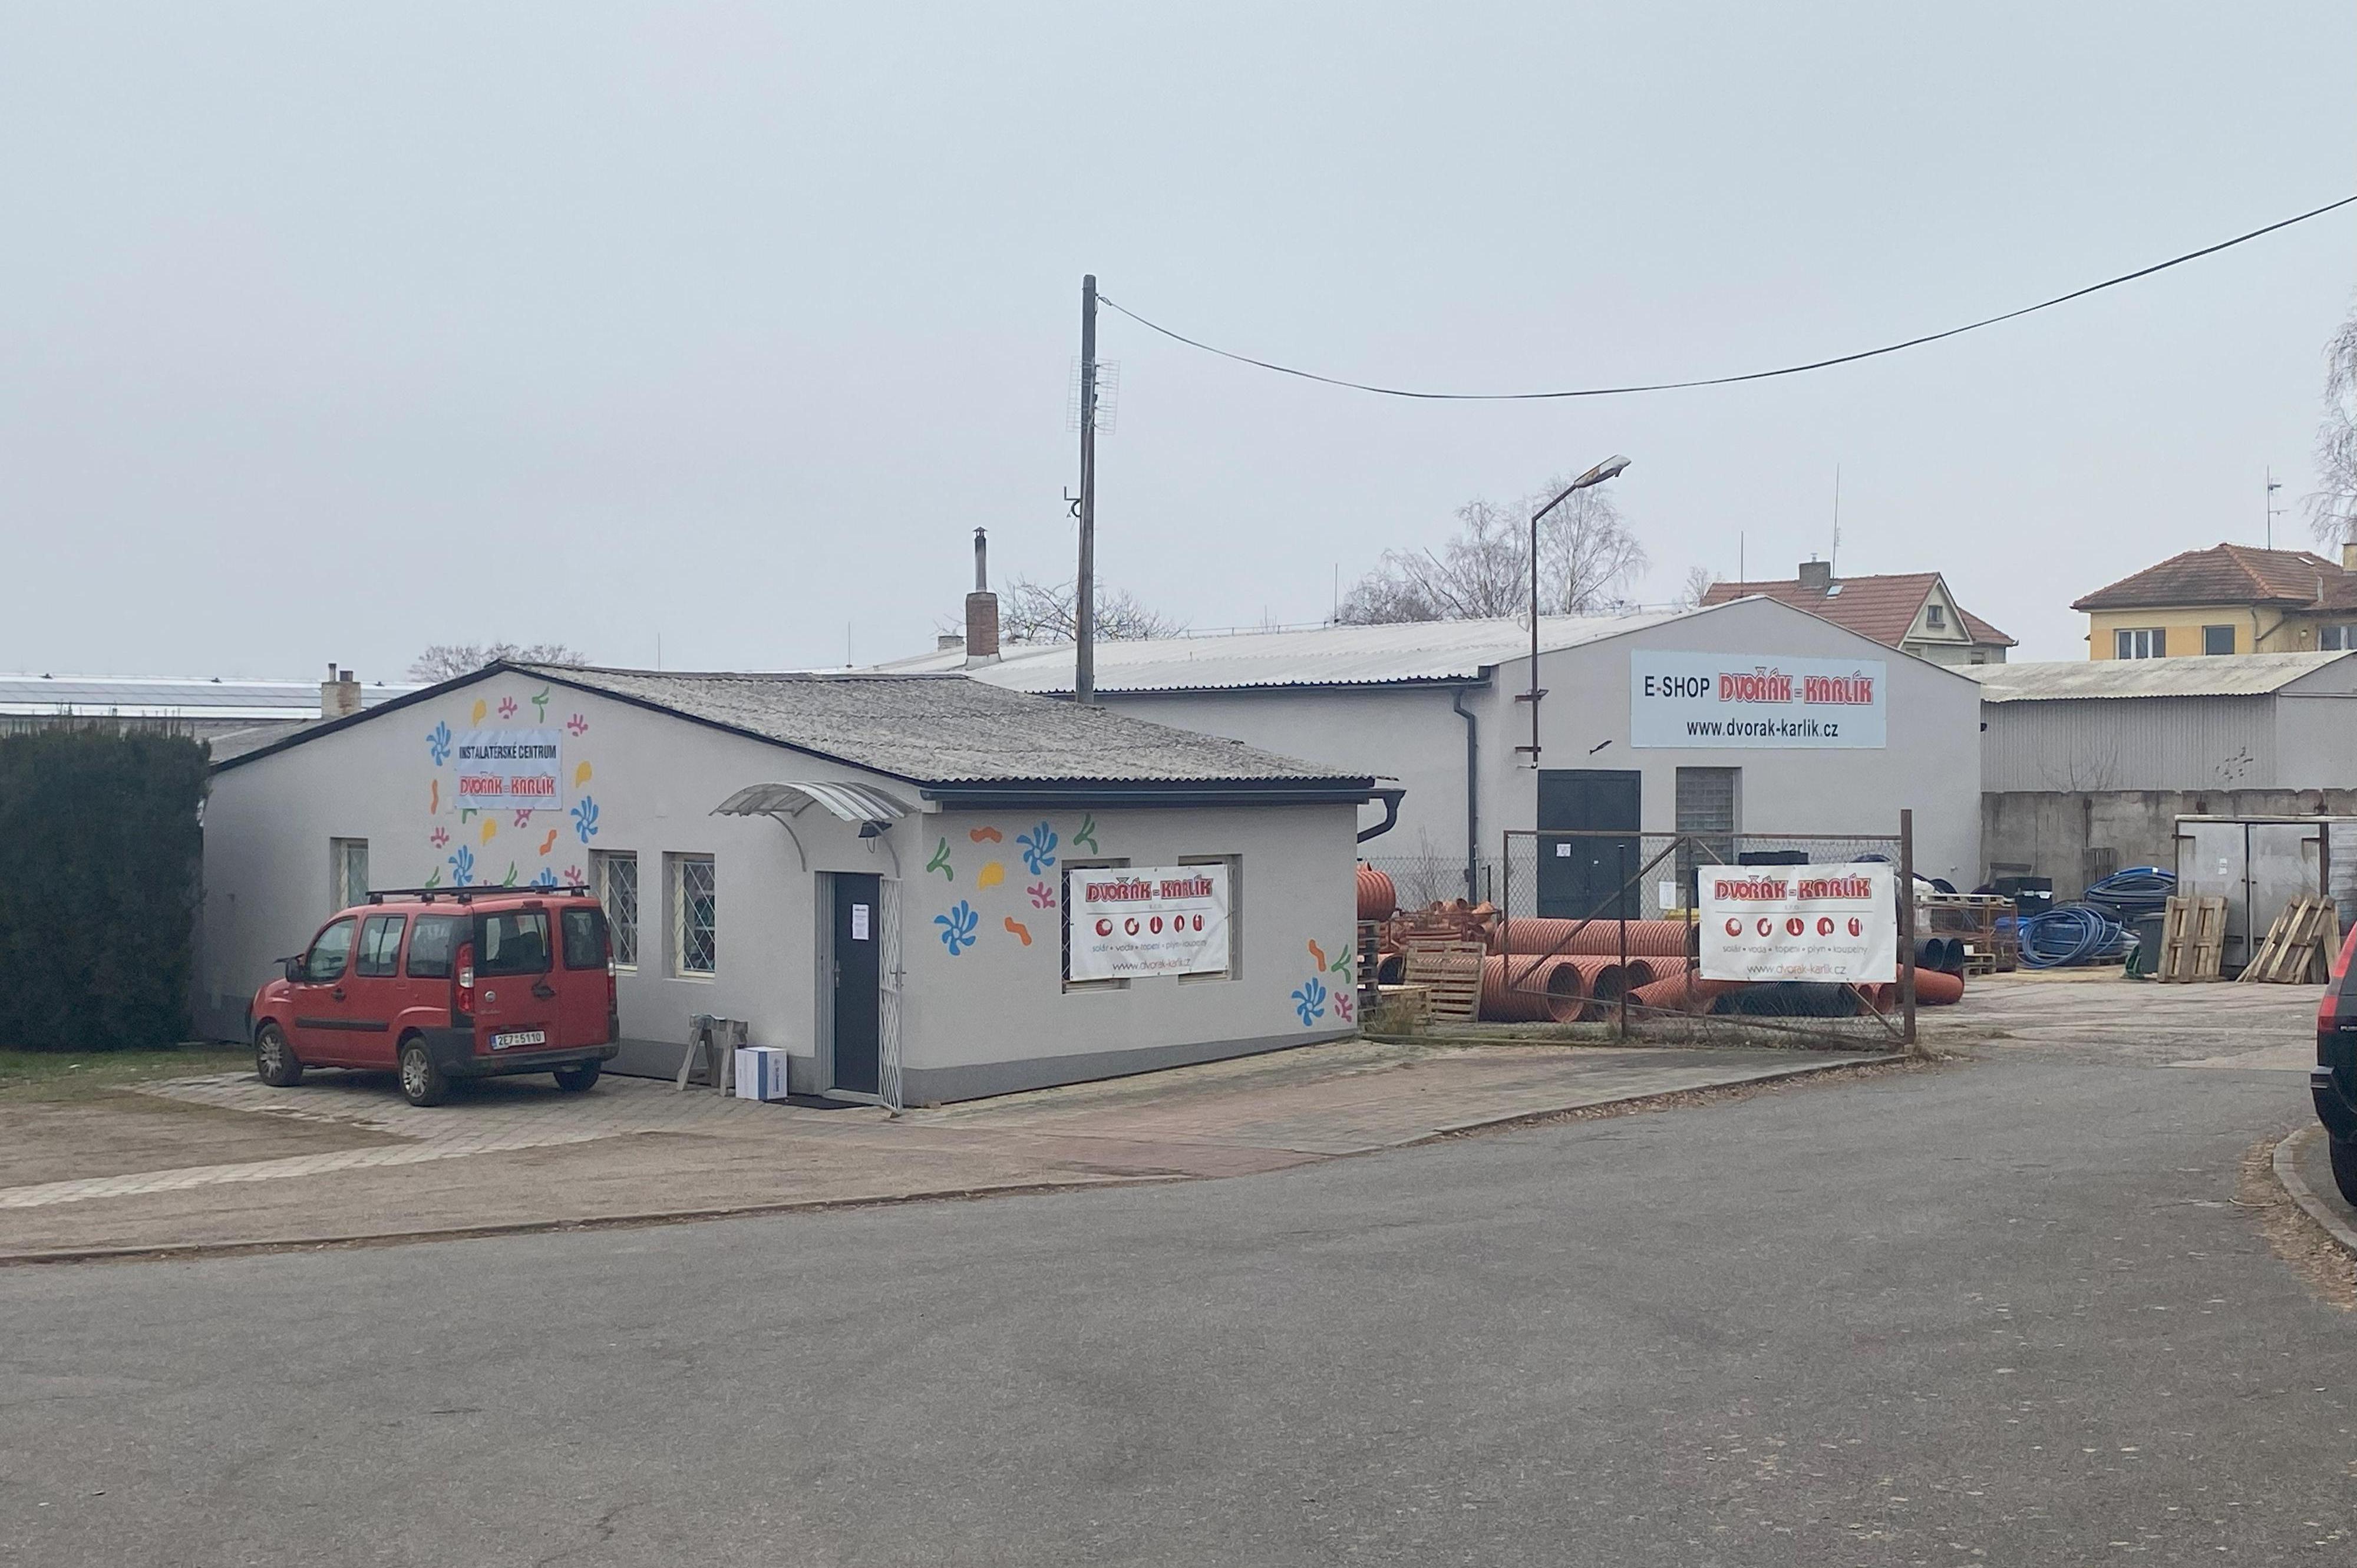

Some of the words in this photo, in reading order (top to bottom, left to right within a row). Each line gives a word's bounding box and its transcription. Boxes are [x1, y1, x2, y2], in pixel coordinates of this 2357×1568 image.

[1644, 676, 1710, 698] E-SHOP
[1686, 718, 1839, 738] www.dvorak-karlik.cz
[518, 745, 557, 759] CENTRUM
[1748, 945, 1767, 953] voda
[1807, 945, 1825, 955] plyn
[1833, 945, 1868, 955] koupelny
[520, 1032, 541, 1044] 5110
